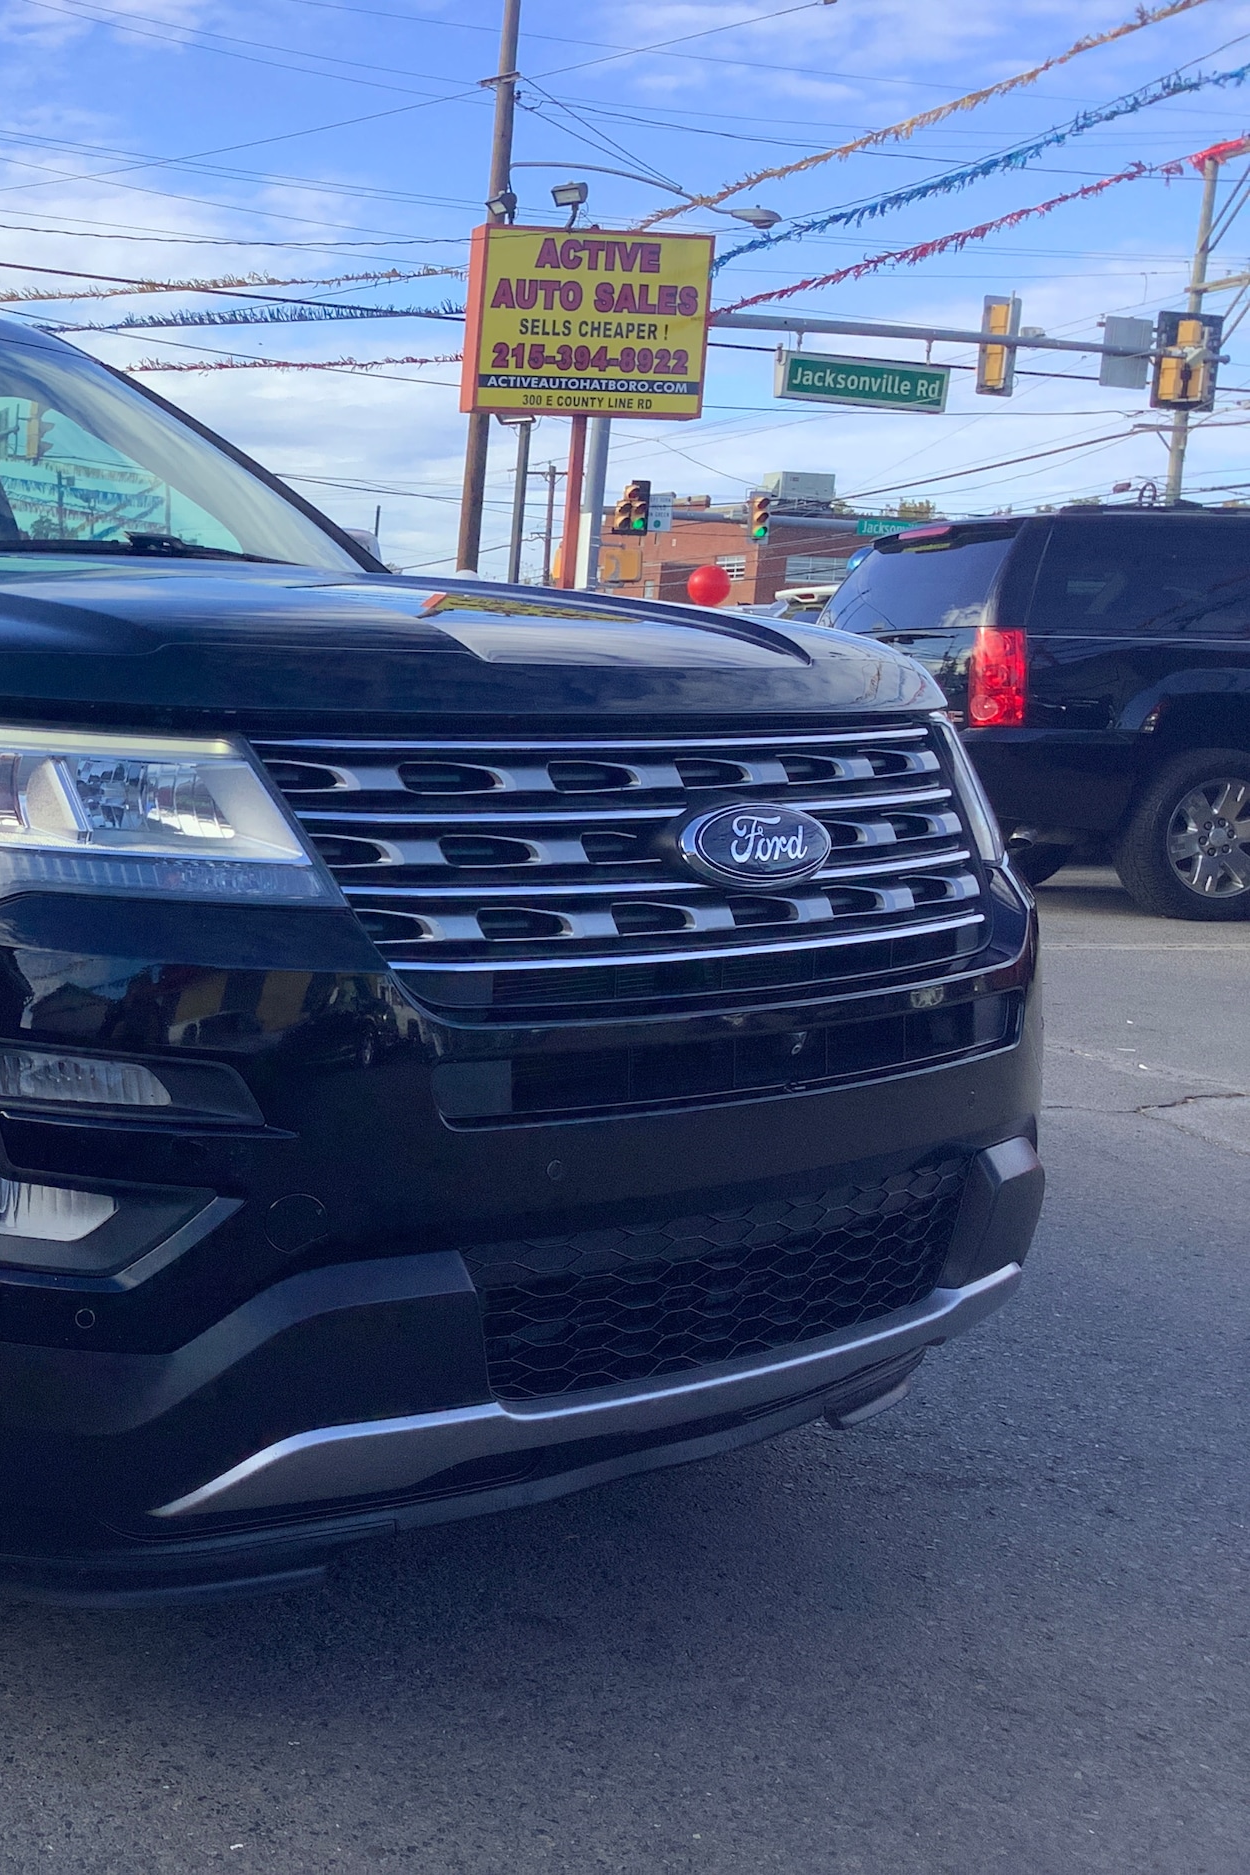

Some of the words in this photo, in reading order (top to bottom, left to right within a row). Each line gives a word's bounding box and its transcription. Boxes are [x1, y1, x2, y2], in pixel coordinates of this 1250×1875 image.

[534, 238, 661, 273] ACTIVE
[490, 278, 583, 311] AUTO
[594, 282, 699, 316] SALES
[519, 318, 572, 337] SELLS
[578, 320, 658, 340] CHEAPER
[491, 342, 689, 375] 215-394-8922
[487, 376, 688, 393] ACTIVEAUTOHATBORO.COM
[792, 367, 912, 396] Jacksonville
[916, 379, 940, 398] Rd
[522, 394, 542, 406] 300
[546, 395, 553, 406] E
[557, 396, 604, 408] COUNTY
[608, 398, 634, 409] LINE
[637, 399, 653, 410] RD
[730, 815, 808, 864] Ford
